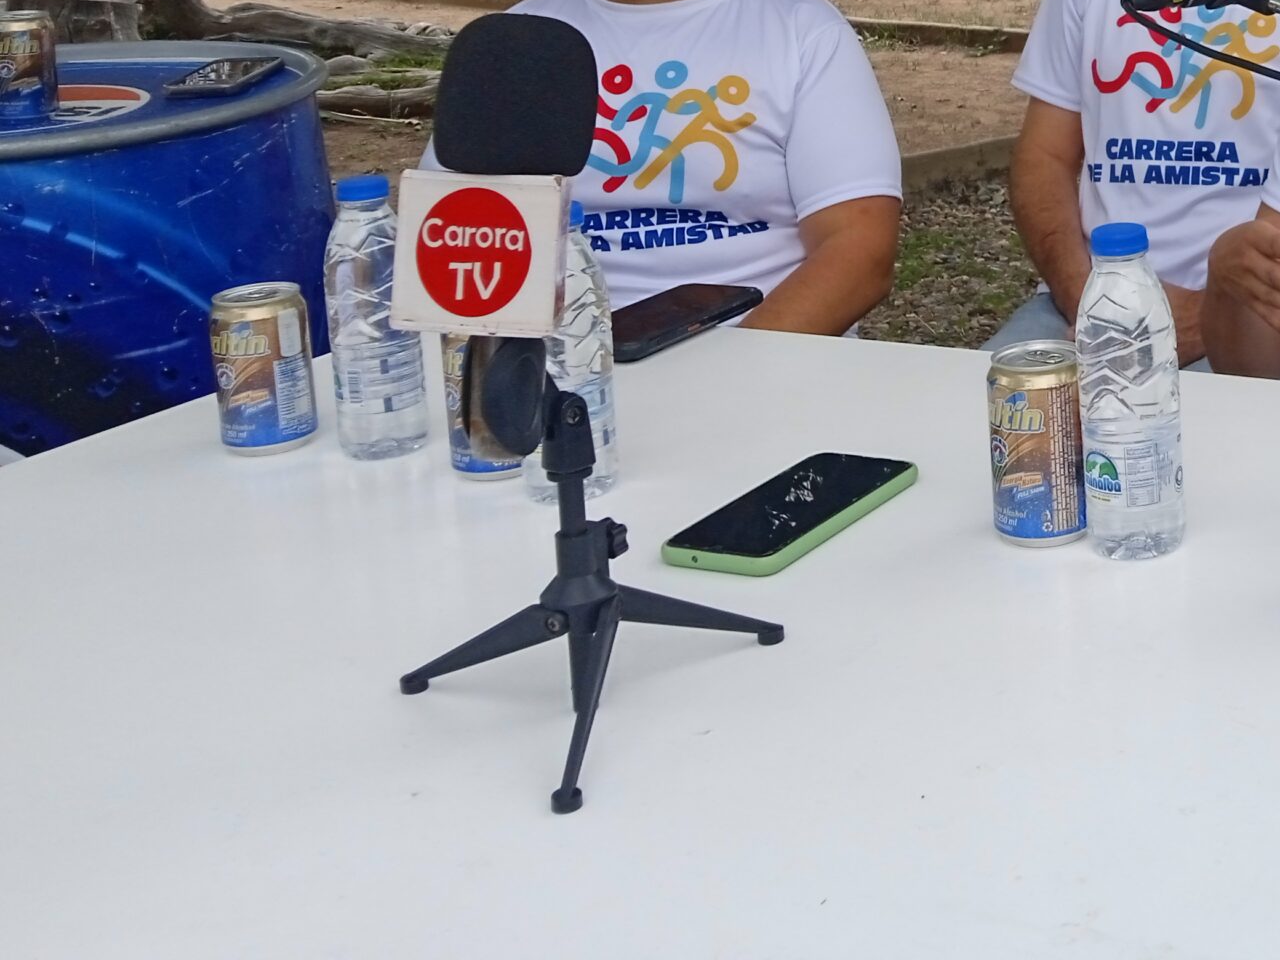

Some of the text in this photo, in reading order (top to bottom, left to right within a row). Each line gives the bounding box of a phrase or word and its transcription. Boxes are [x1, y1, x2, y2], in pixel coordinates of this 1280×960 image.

[1106, 138, 1240, 164] CARRERA
[1109, 164, 1136, 183] LA
[581, 208, 728, 234] ARRERA
[422, 217, 525, 252] Carora
[589, 220, 769, 252] A AMISTAD
[448, 261, 502, 301] TV
[212, 330, 268, 356] altín
